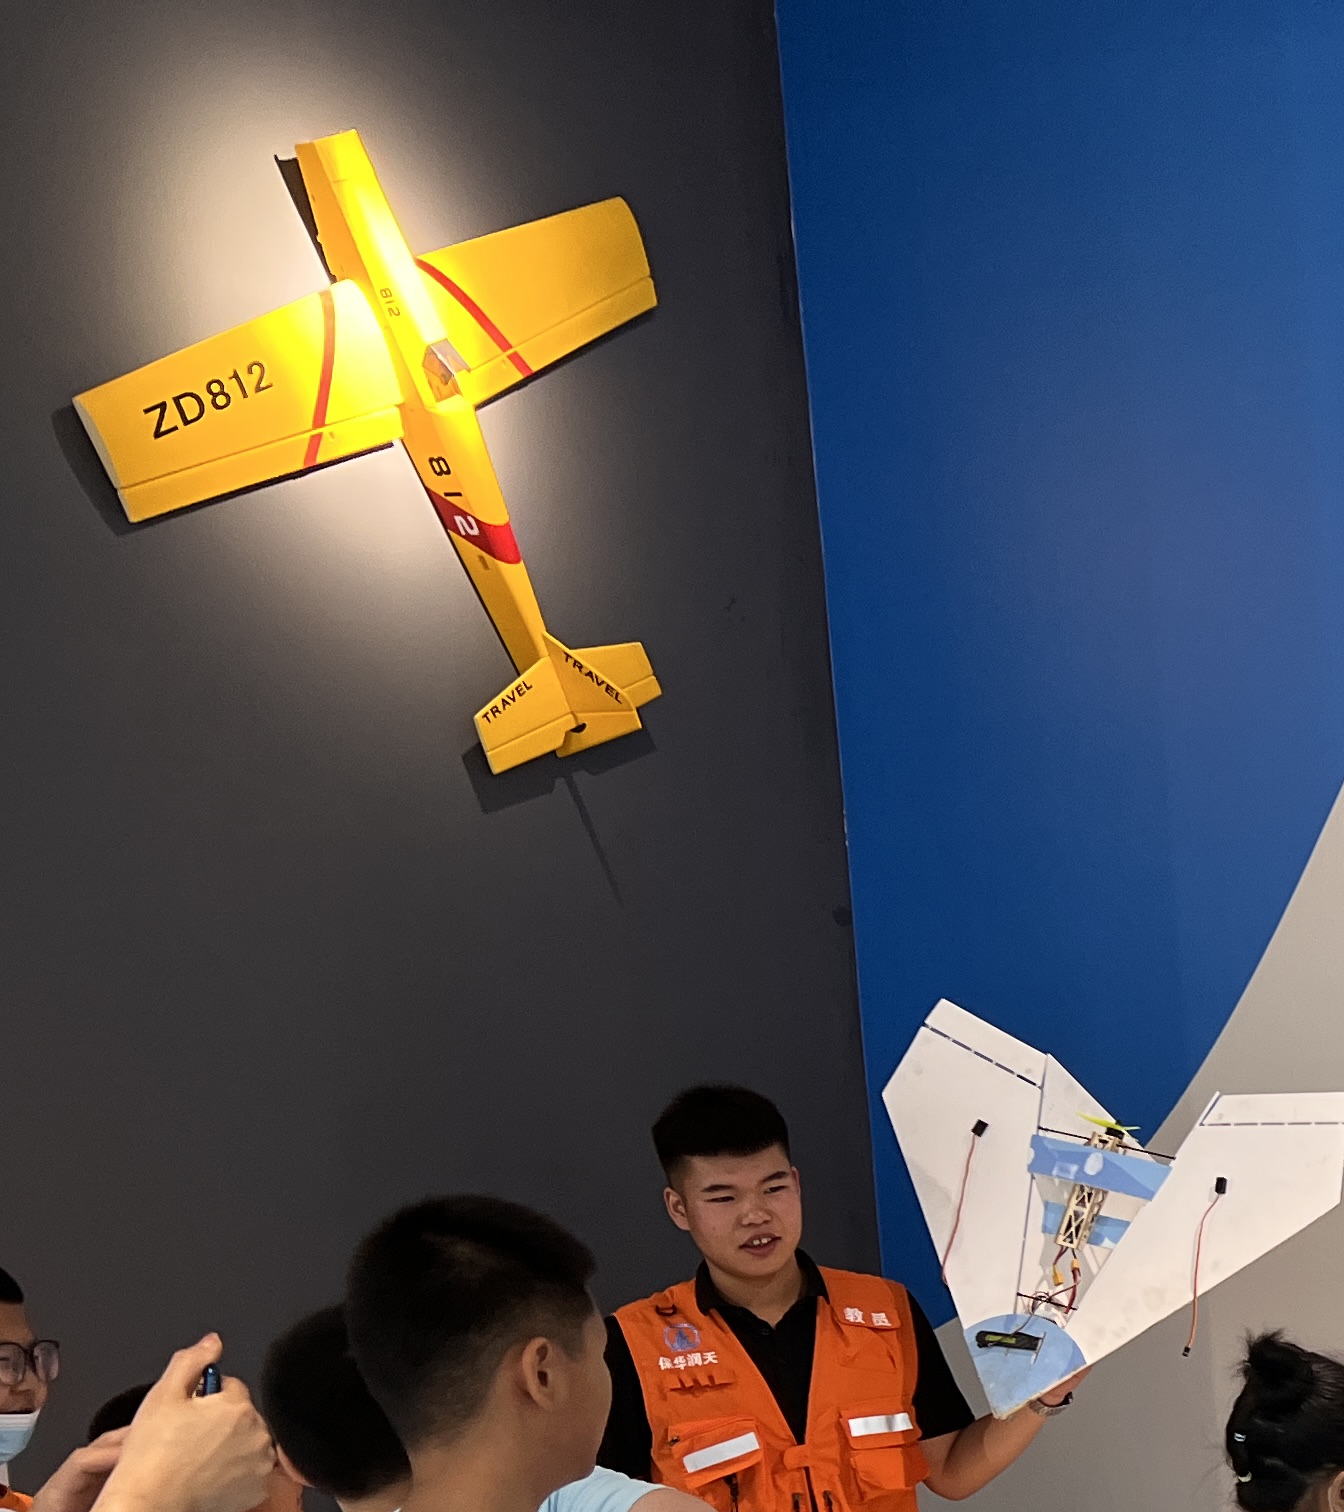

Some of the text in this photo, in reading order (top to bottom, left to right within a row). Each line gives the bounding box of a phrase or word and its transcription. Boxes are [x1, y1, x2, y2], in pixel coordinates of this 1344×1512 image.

[142, 360, 274, 440] ZD812
[428, 456, 480, 536] 812
[482, 680, 533, 724] TRAVEL
[563, 650, 622, 704] TRAVEL
[843, 1307, 892, 1327] 教员
